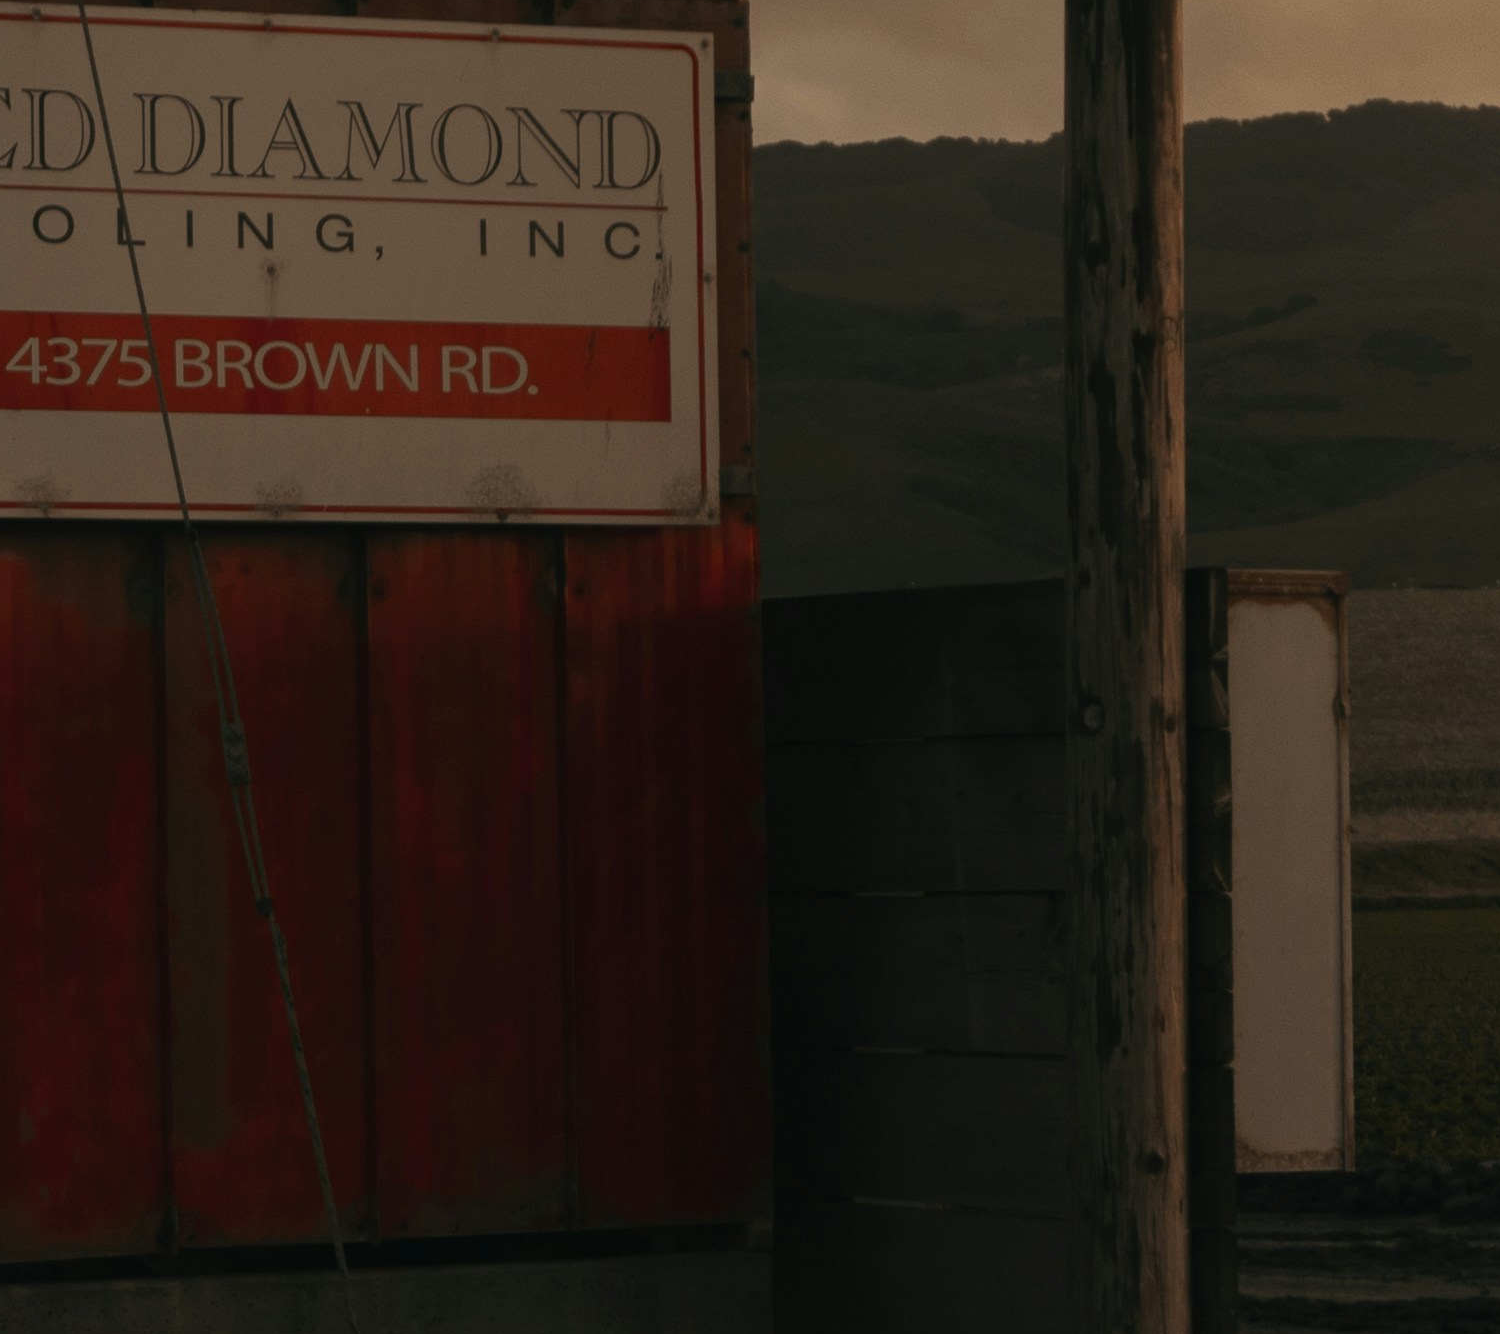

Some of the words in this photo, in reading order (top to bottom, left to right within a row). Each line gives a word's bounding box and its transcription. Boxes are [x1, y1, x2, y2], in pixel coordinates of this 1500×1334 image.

[133, 92, 662, 190] DIAMOND
[480, 219, 664, 261] INC.
[4, 336, 153, 388] 4375
[174, 340, 421, 394] BROWN
[440, 345, 540, 397] RD.
